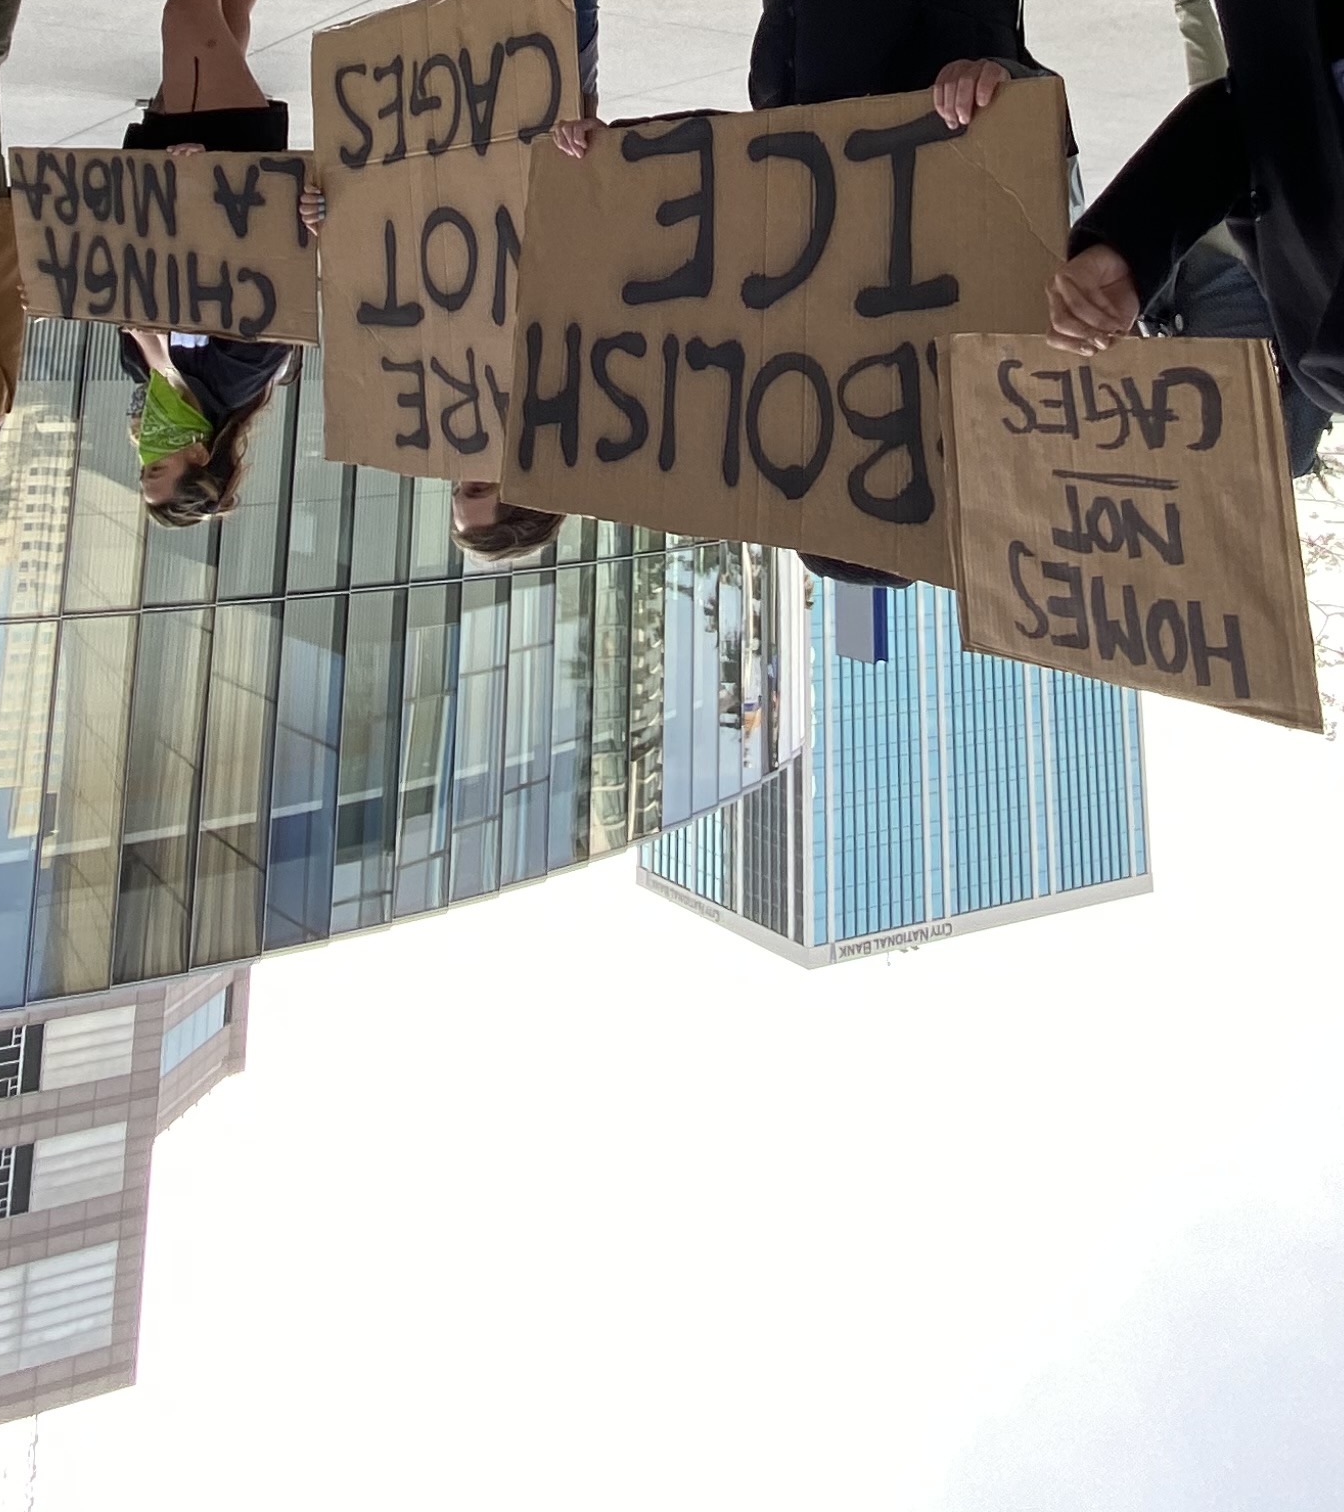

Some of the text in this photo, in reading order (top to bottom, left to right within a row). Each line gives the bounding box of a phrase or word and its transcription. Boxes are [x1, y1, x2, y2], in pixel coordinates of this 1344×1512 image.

[334, 32, 562, 171] CAGES
[10, 151, 308, 249] LA MIGRA
[620, 111, 966, 319] ICE
[37, 226, 277, 339] CHINGA
[517, 321, 944, 526] BOLISH
[998, 359, 1223, 451] CAGES
[1052, 485, 1184, 565] NOT
[1009, 540, 1250, 699] HOMES
[838, 922, 953, 959] CITY NATIONAL BANK
